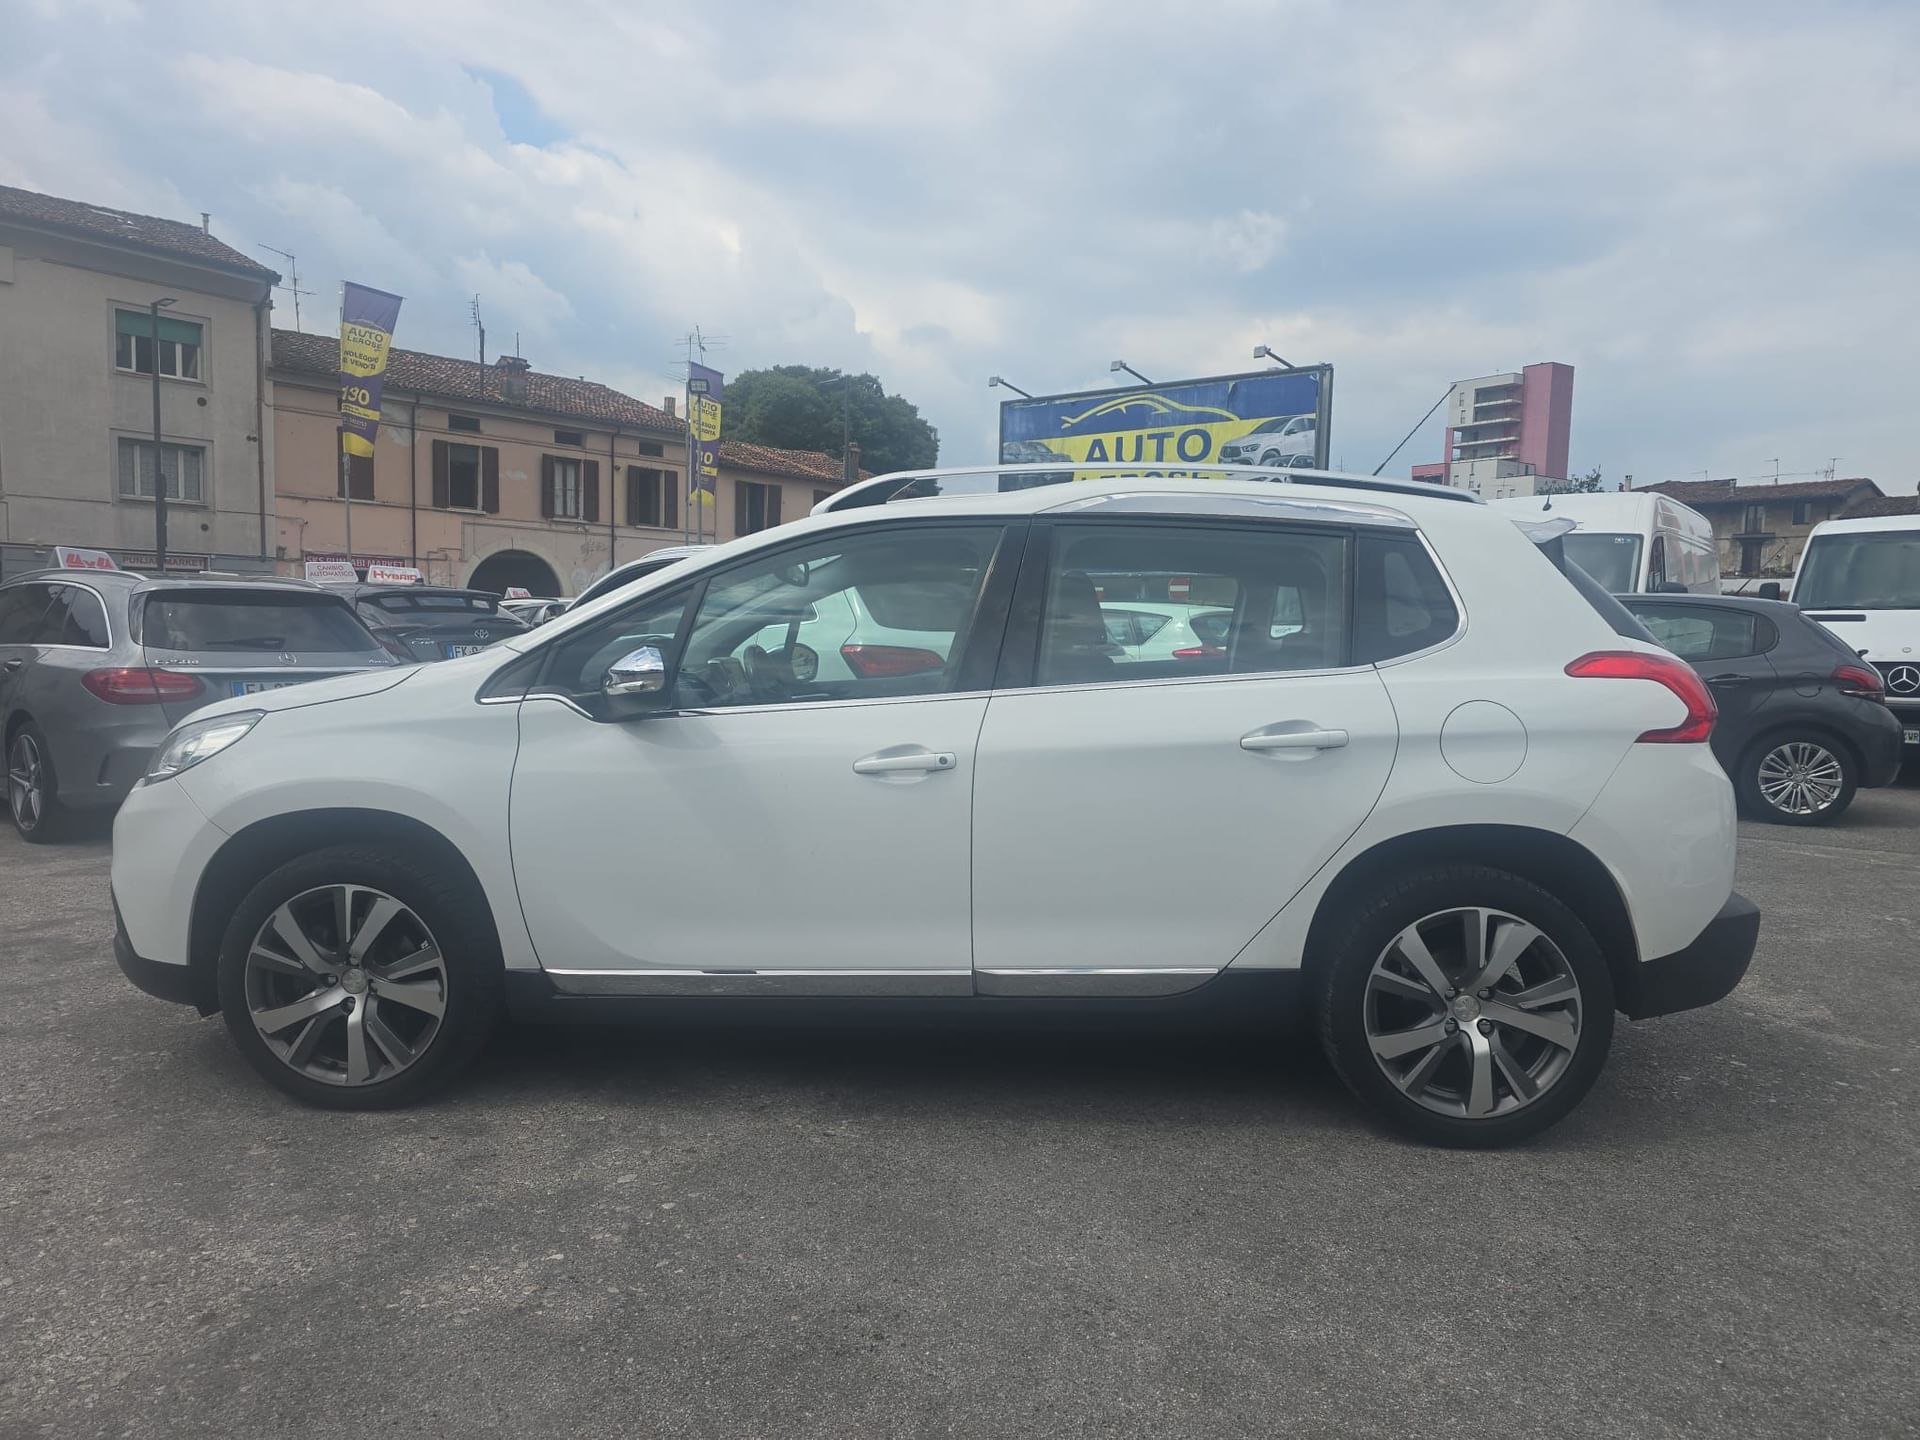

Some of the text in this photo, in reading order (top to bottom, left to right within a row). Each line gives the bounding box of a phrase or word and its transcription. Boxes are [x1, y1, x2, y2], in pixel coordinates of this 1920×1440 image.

[347, 335, 383, 350] LEROSE
[348, 327, 384, 343] AUTO
[342, 385, 370, 405] 130
[1085, 428, 1212, 463] AUTO
[122, 555, 204, 569] PUNJA MARKET
[326, 557, 366, 568] PUNABI
